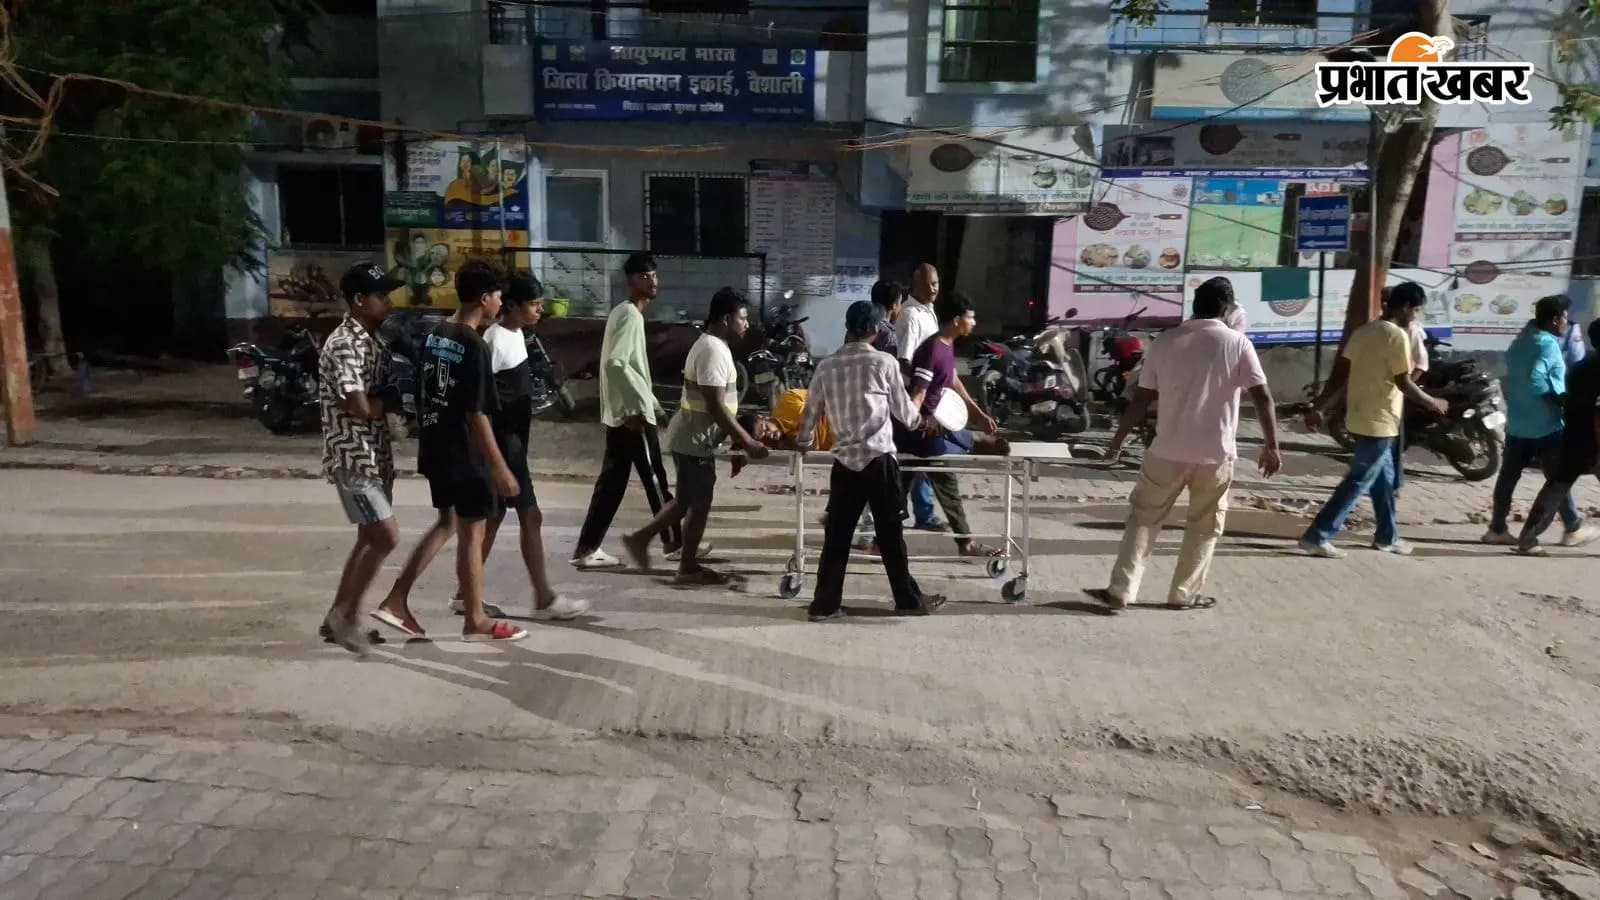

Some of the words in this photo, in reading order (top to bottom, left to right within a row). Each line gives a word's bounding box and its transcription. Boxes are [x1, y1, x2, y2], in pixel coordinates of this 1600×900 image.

[695, 47, 736, 62] भारत
[542, 67, 588, 90] जिला
[594, 67, 682, 92] क्रियान्वयन
[687, 71, 740, 96] इकाई,
[748, 70, 804, 94] वैशाली
